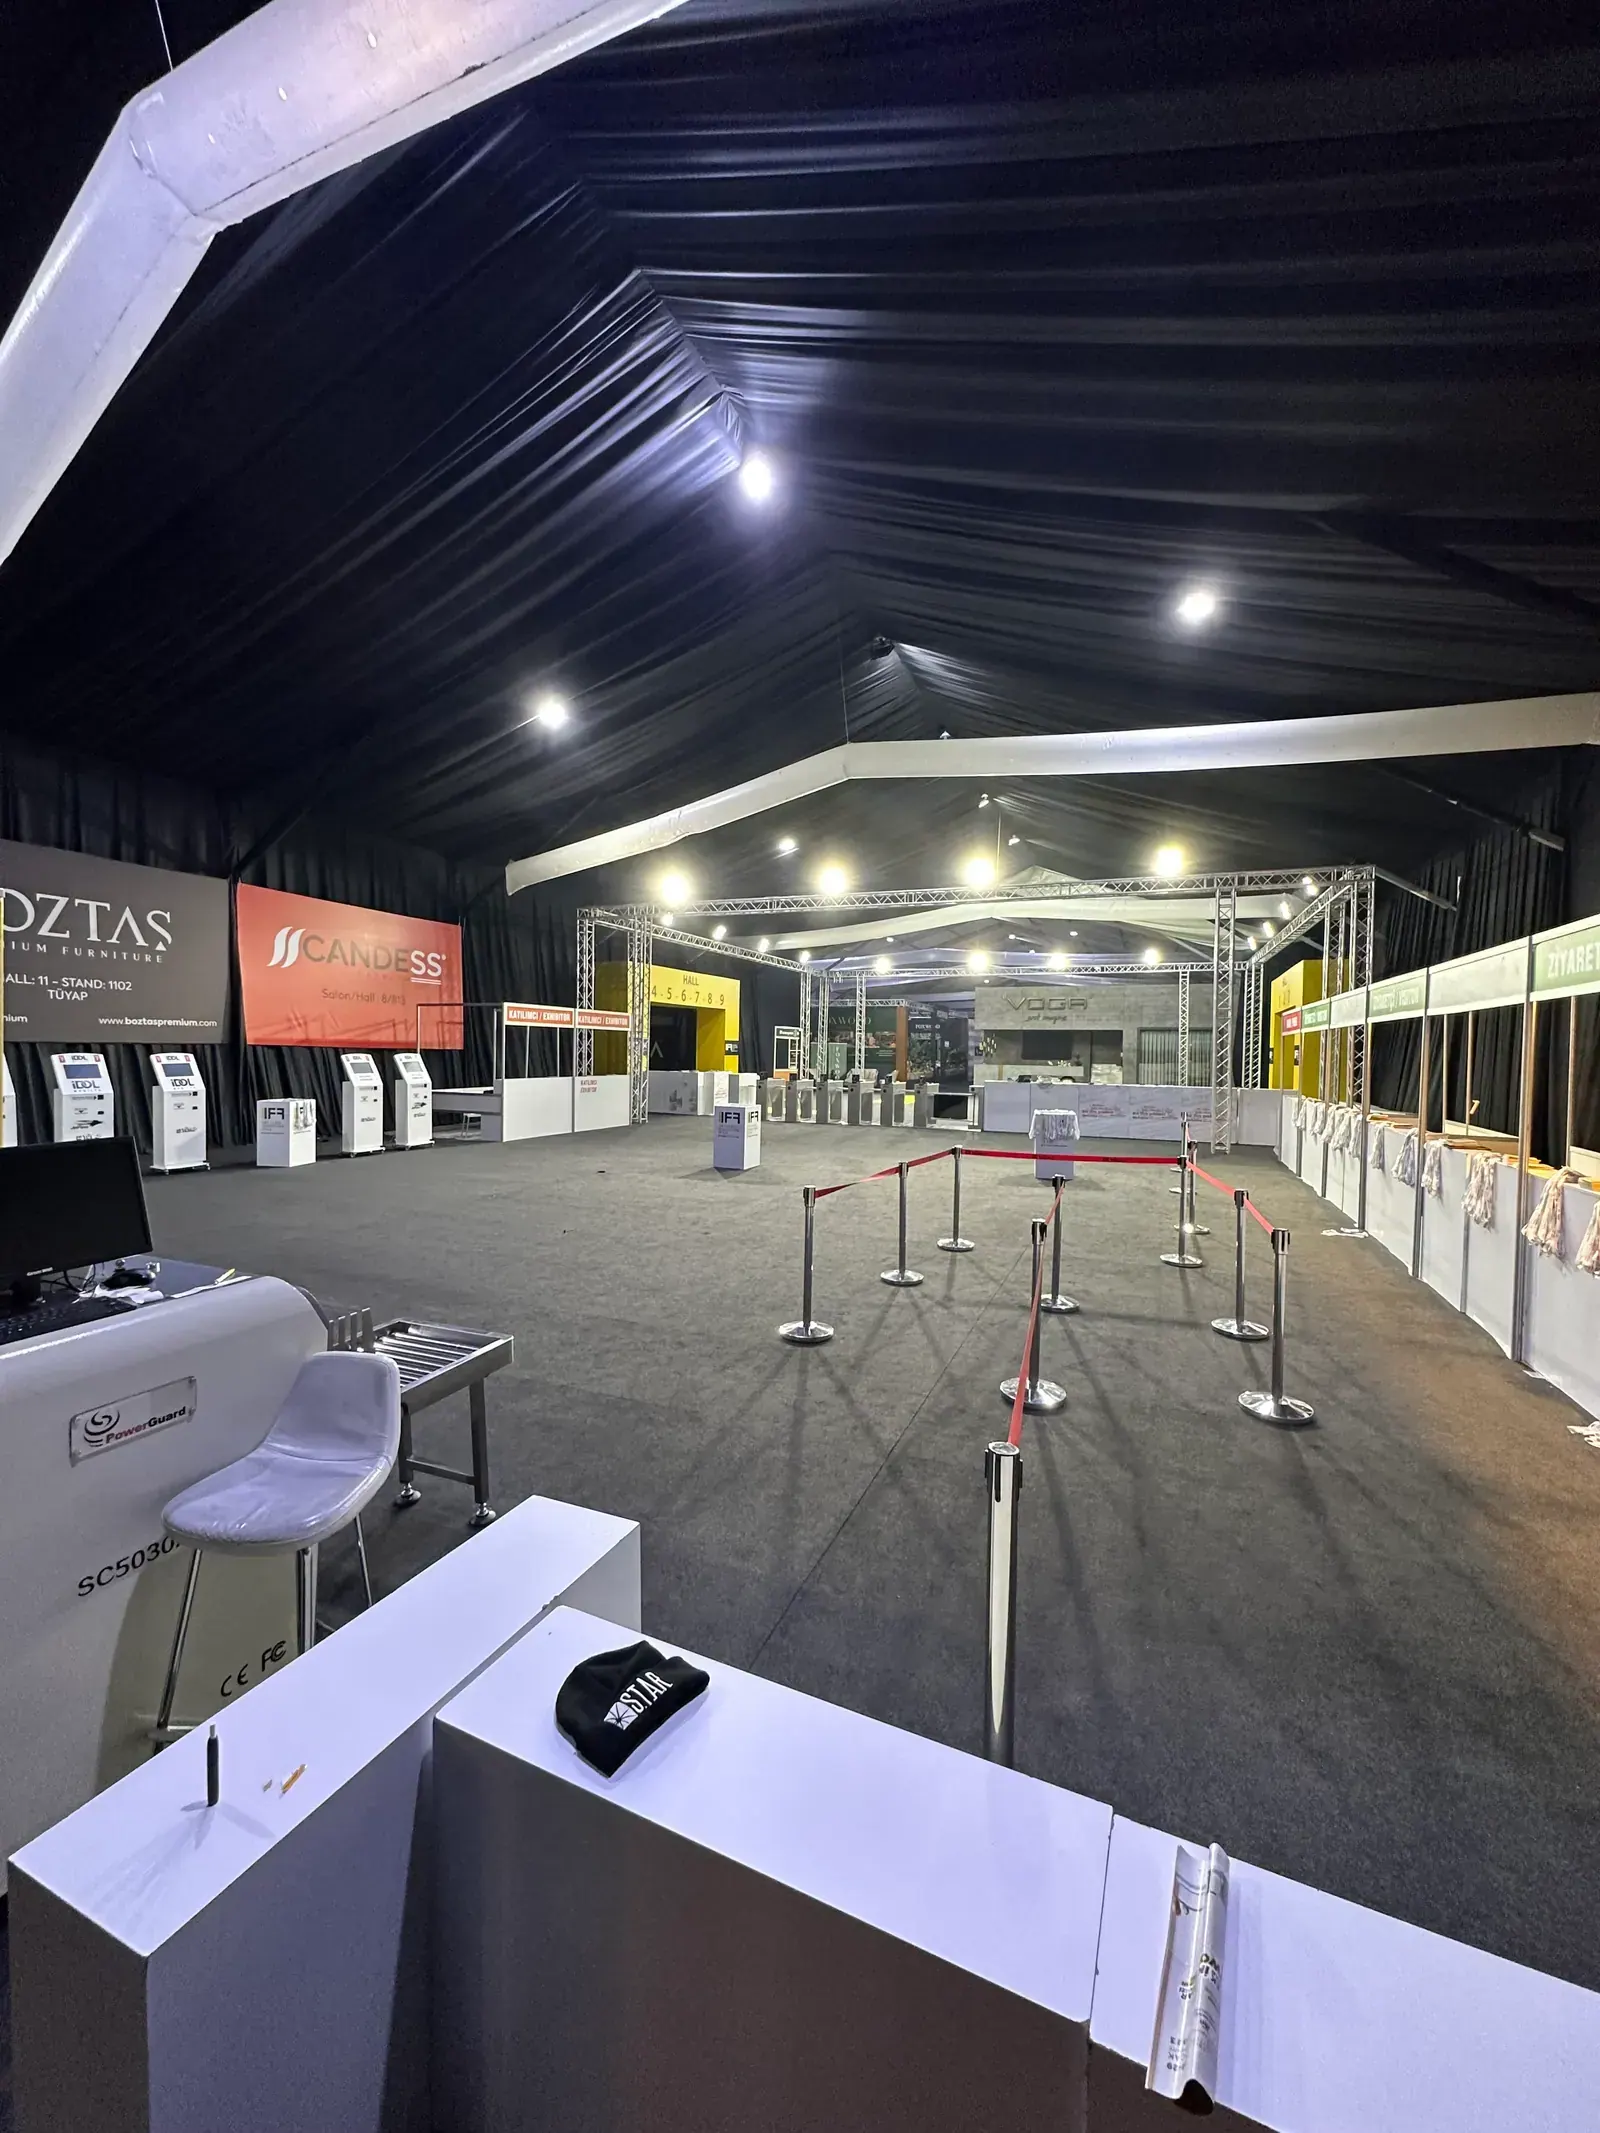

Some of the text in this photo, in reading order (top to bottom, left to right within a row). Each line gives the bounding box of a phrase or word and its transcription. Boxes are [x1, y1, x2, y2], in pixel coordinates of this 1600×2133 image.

[62, 946, 163, 963] FURNITURE
[302, 934, 443, 980] CANDESS
[3, 973, 36, 985] ALL:
[37, 975, 49, 986] 11
[62, 977, 107, 990] STAND:
[108, 979, 132, 991] 1102
[683, 975, 699, 986] HALL
[48, 988, 89, 1001] TÜYAP
[1007, 997, 1087, 1011] VOGA
[99, 1017, 218, 1028] www.boztaspremium.com
[105, 1406, 186, 1444] PowerGuard
[77, 1536, 180, 1597] SC5030
